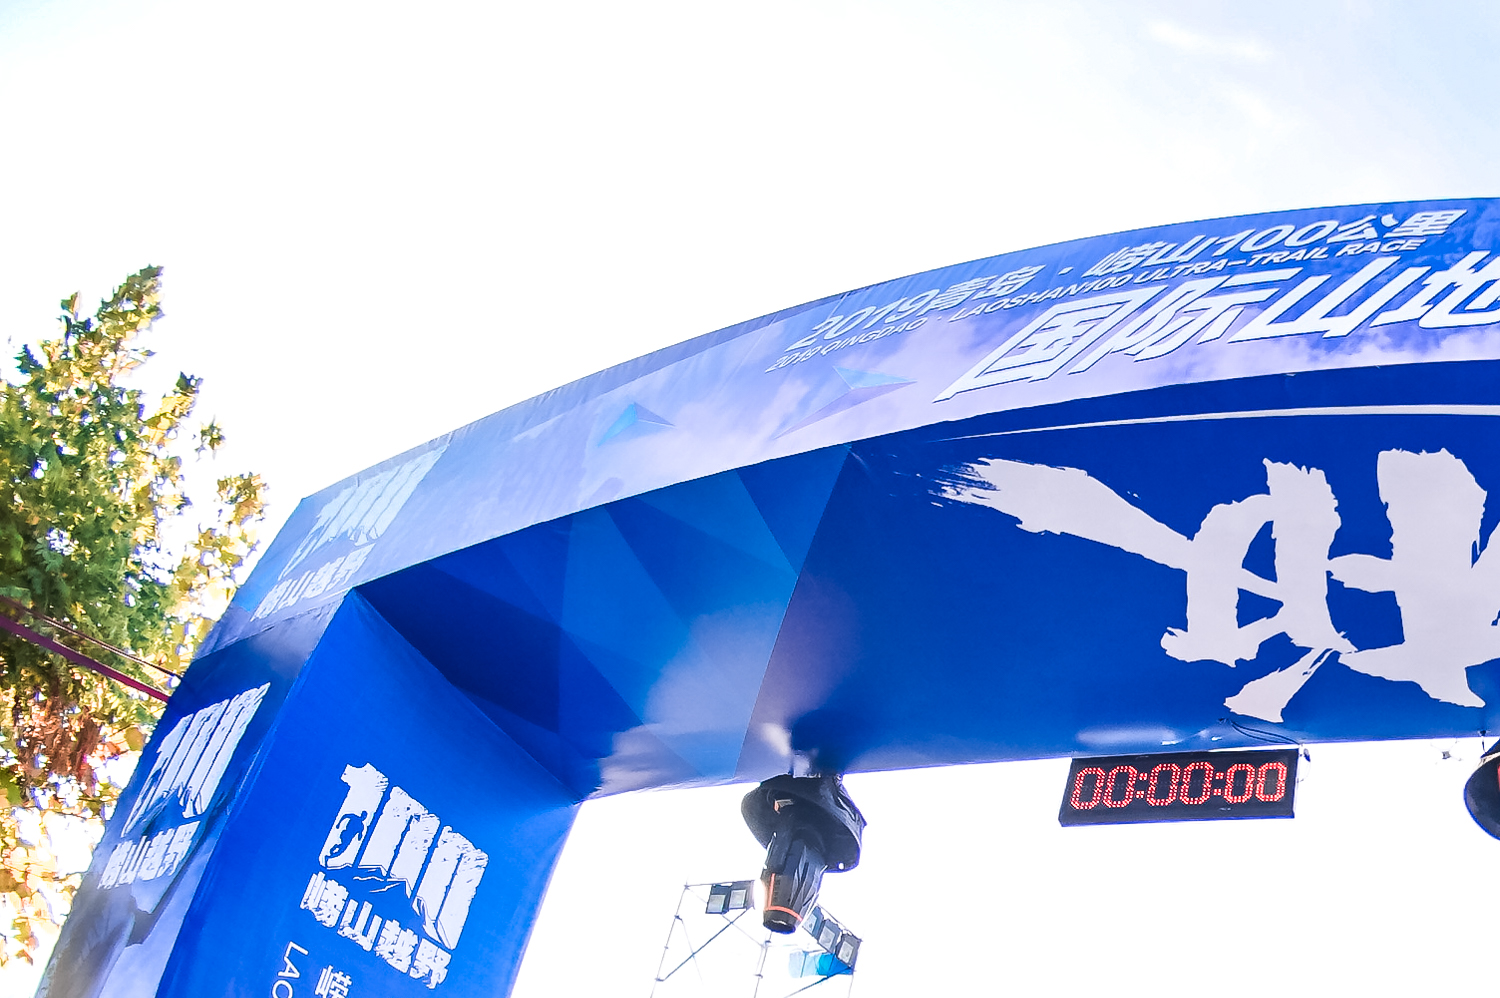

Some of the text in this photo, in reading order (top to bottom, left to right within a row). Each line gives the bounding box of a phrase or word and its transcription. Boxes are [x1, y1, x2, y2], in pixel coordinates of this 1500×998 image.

[765, 346, 824, 374] 2019
[820, 317, 928, 356] QINGDAO
[1336, 238, 1427, 258] RACE
[1070, 761, 1288, 810] 00:00:00
[300, 871, 455, 990] 崂山越野
